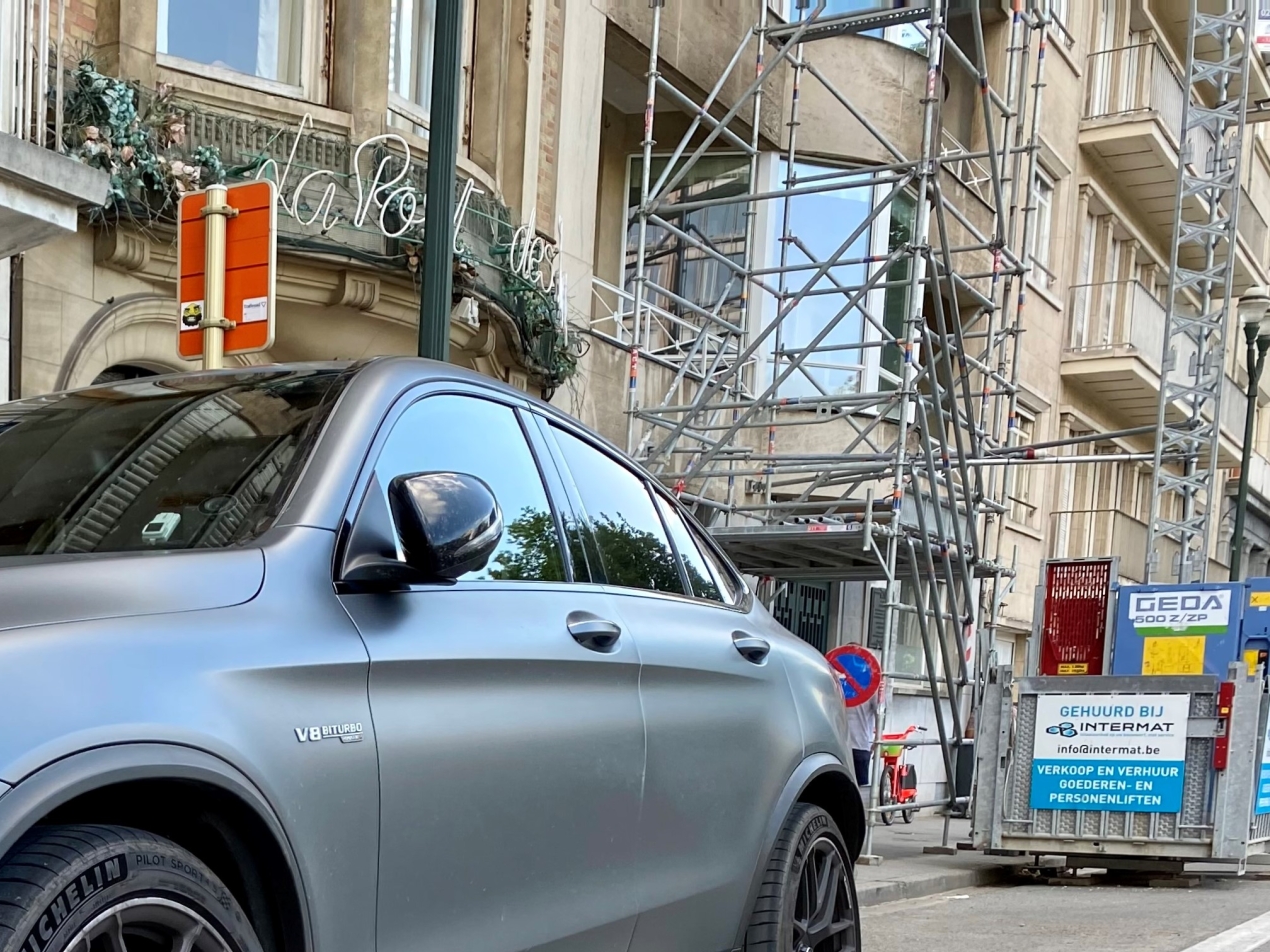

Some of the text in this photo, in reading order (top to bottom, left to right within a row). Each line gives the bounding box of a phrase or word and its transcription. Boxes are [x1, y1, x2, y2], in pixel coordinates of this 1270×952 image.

[1135, 595, 1223, 612] GEDA
[1135, 613, 1208, 624] 500 Z/ZP
[1060, 705, 1164, 718] GEHUURD BIJ
[294, 722, 363, 742] V8 BITURBO
[1080, 722, 1175, 732] INTERMAT
[1057, 744, 1160, 755] info@intermat.be
[1037, 764, 1179, 777] VERKOOP EN VERHUUR
[1059, 779, 1153, 791] GOEDEREN- EN
[1049, 793, 1161, 806] PERSONENLIFTEN
[135, 854, 167, 865] PILOT
[170, 859, 205, 882] SPORT
